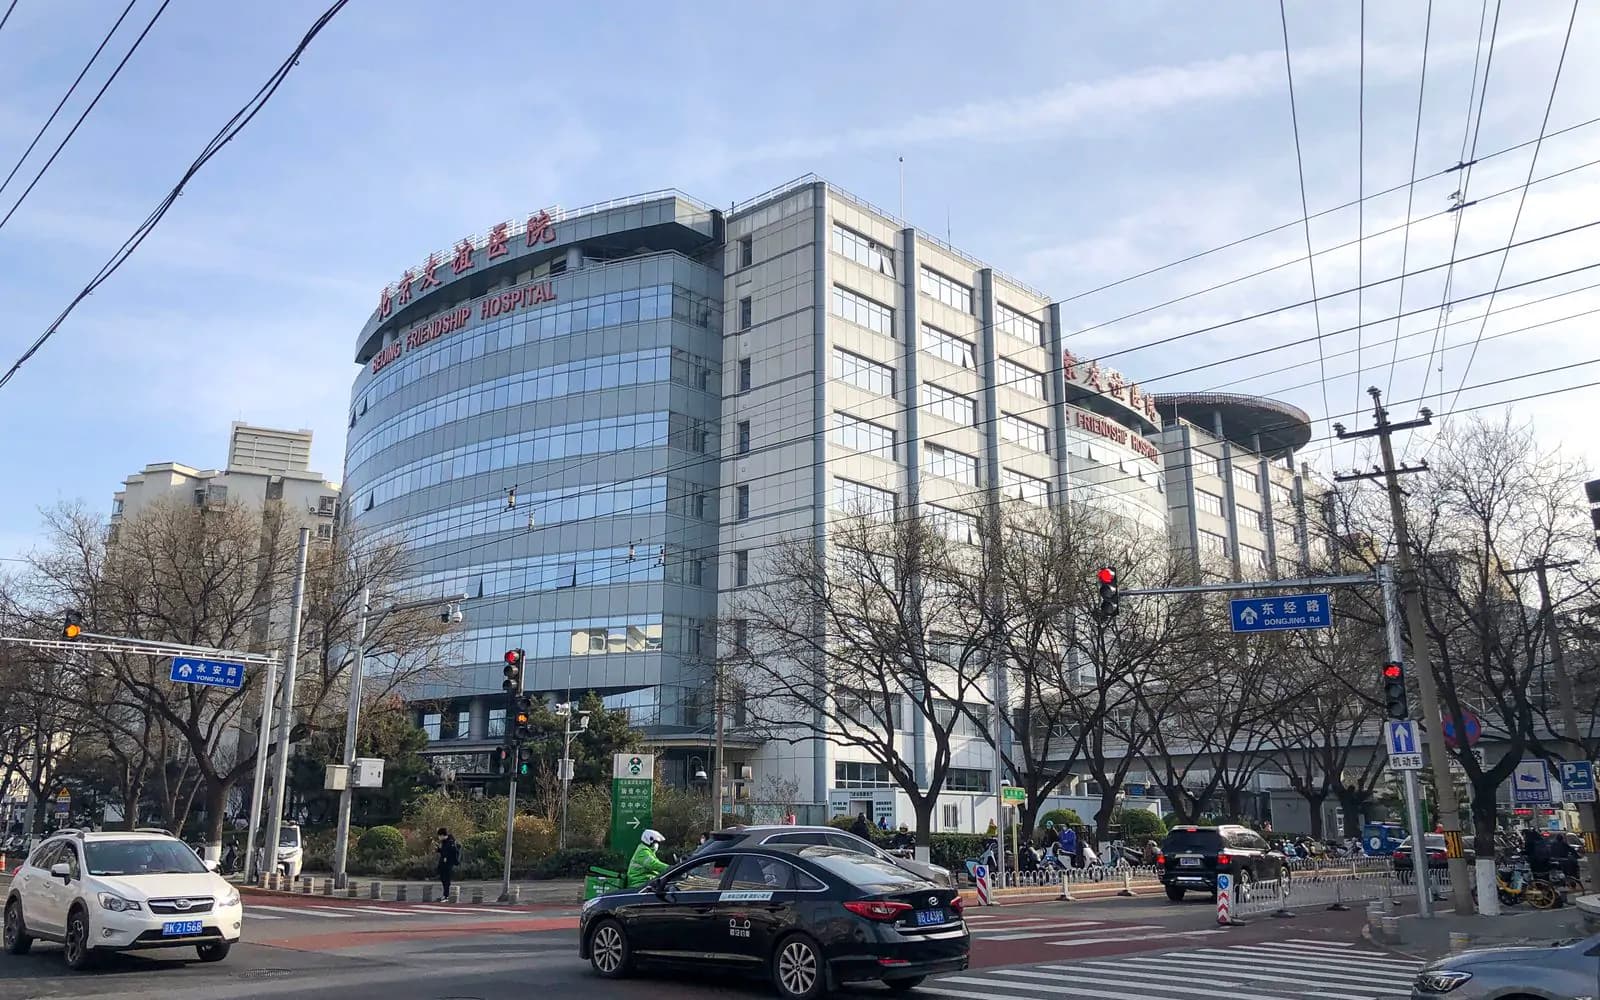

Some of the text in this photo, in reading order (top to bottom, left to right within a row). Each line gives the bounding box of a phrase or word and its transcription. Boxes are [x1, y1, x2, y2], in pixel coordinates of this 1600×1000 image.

[377, 209, 556, 321] 北京友谊医院
[372, 281, 556, 374] BEIJING FRIENDSHIP HOSPITAL
[1076, 412, 1128, 445] FRIENDSHIP
[1131, 435, 1159, 464] HOSPITAL
[1261, 600, 1320, 615] 东经路
[1264, 617, 1306, 626] DONGJING
[197, 663, 237, 677] 永安路
[1392, 756, 1421, 767] 机动车
[1563, 764, 1577, 779] P
